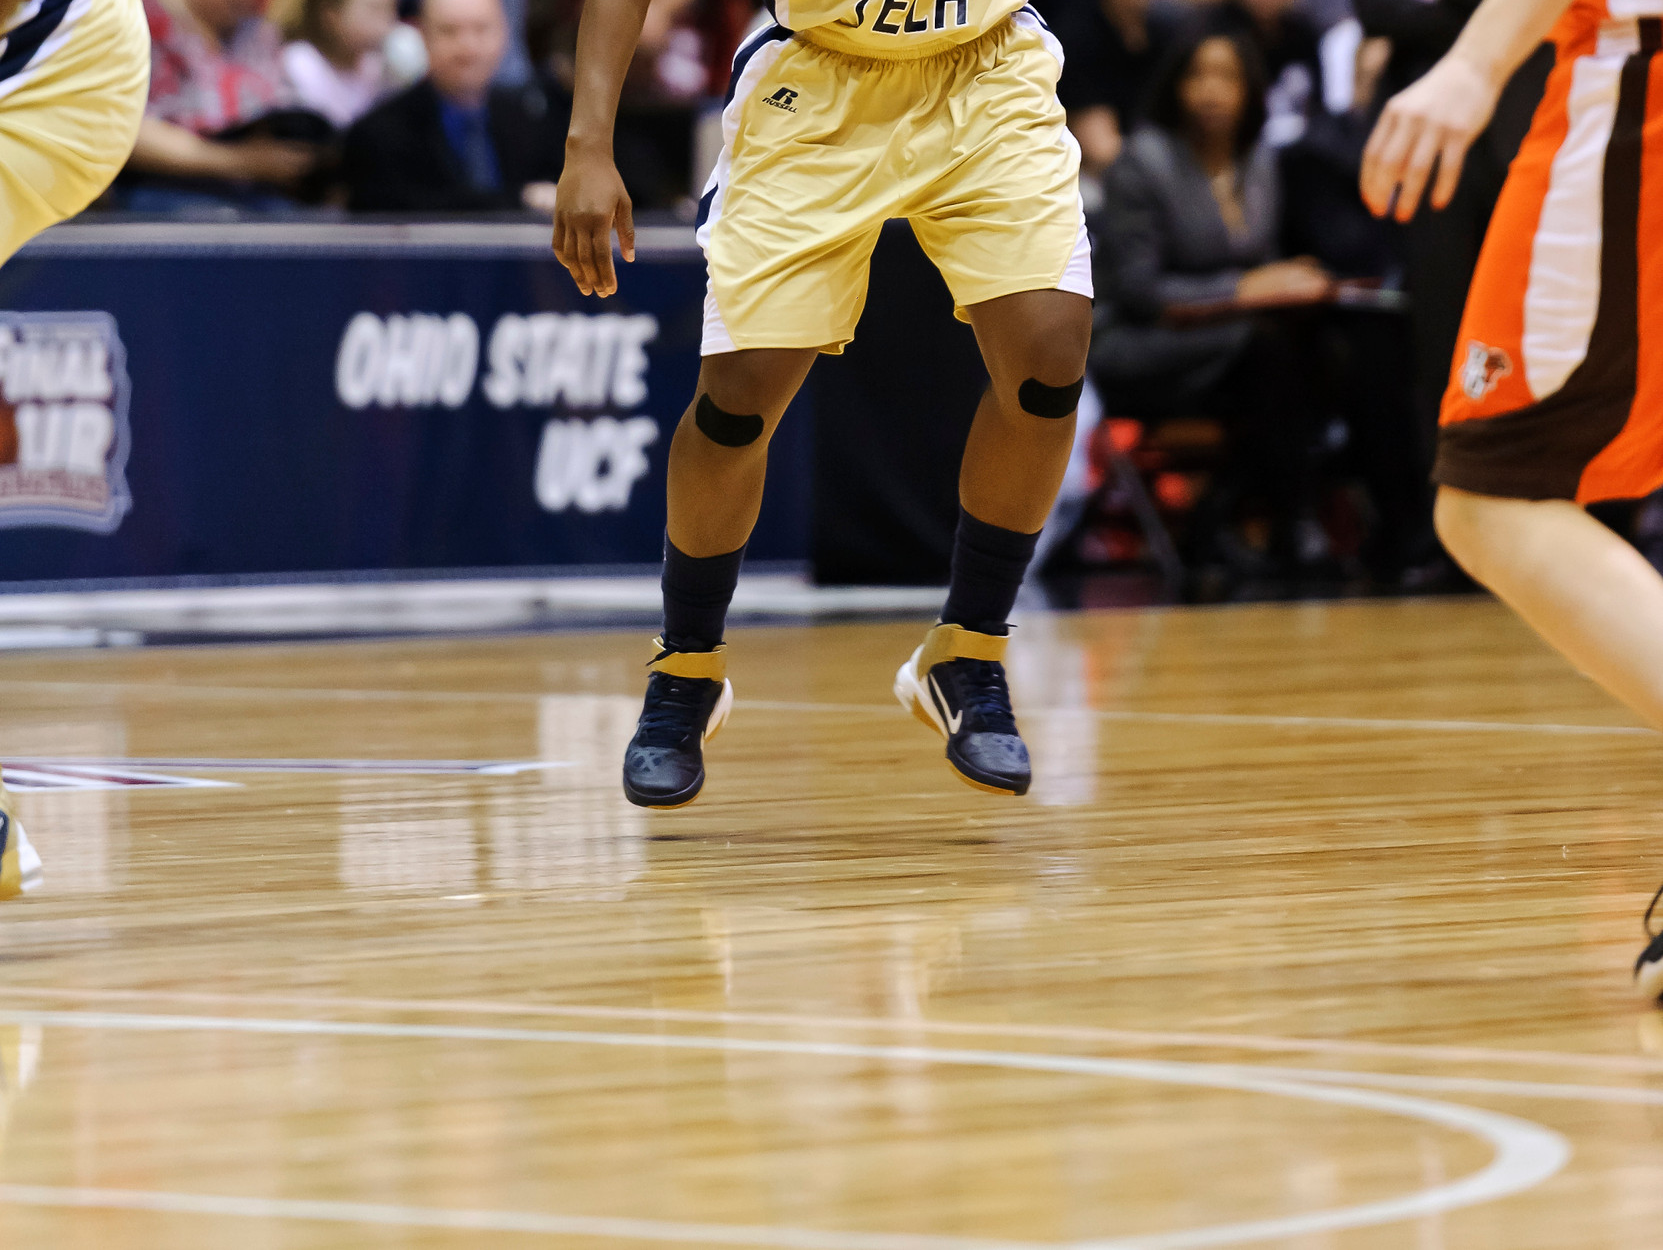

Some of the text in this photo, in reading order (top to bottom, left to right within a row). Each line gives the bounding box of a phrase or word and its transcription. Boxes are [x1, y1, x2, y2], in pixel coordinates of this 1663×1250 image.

[761, 97, 798, 114] RUSSELL
[335, 312, 660, 408] OHIO STATE
[535, 416, 660, 513] UCF
